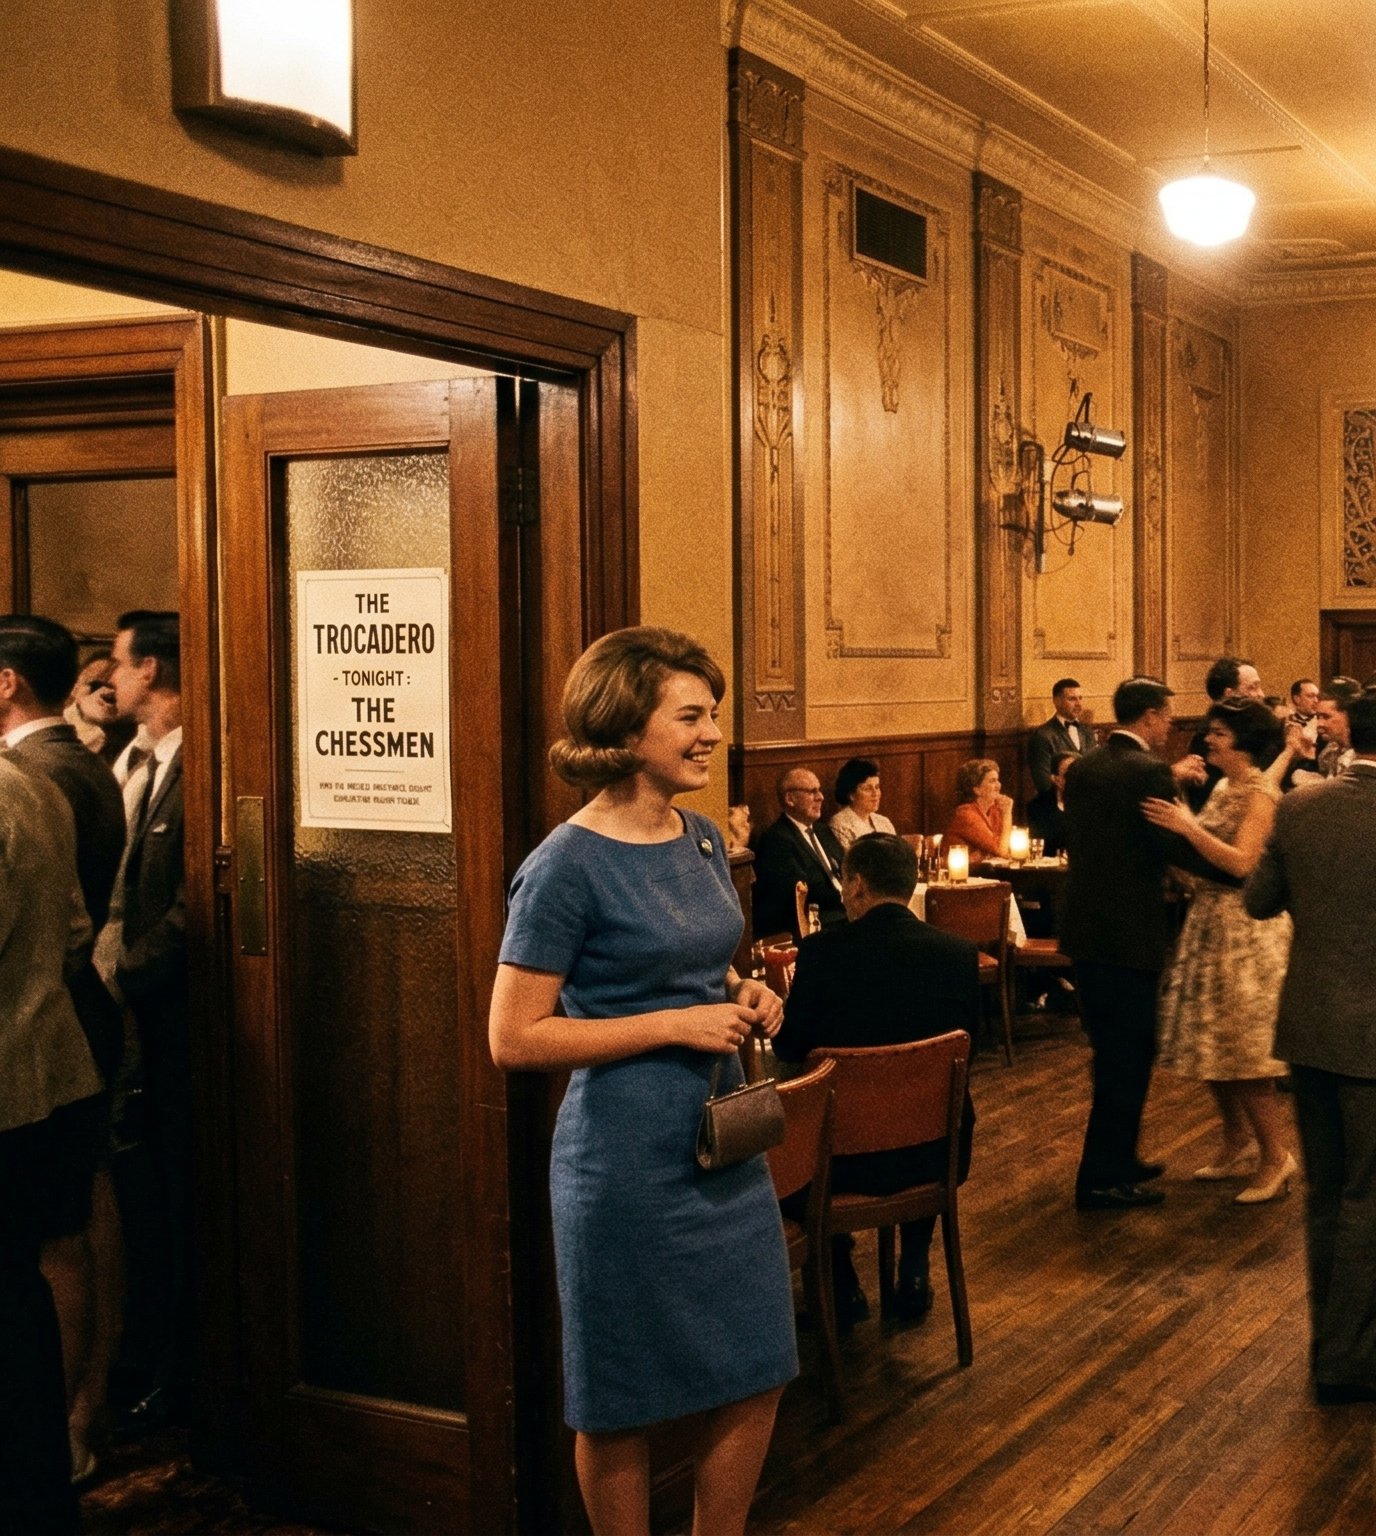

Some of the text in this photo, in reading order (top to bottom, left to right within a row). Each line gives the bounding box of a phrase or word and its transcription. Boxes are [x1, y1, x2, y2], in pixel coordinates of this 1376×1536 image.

[355, 593, 390, 614] THE
[313, 623, 435, 655] TROCADERO
[351, 697, 396, 723] THE
[315, 730, 435, 758] CHESSMEN
